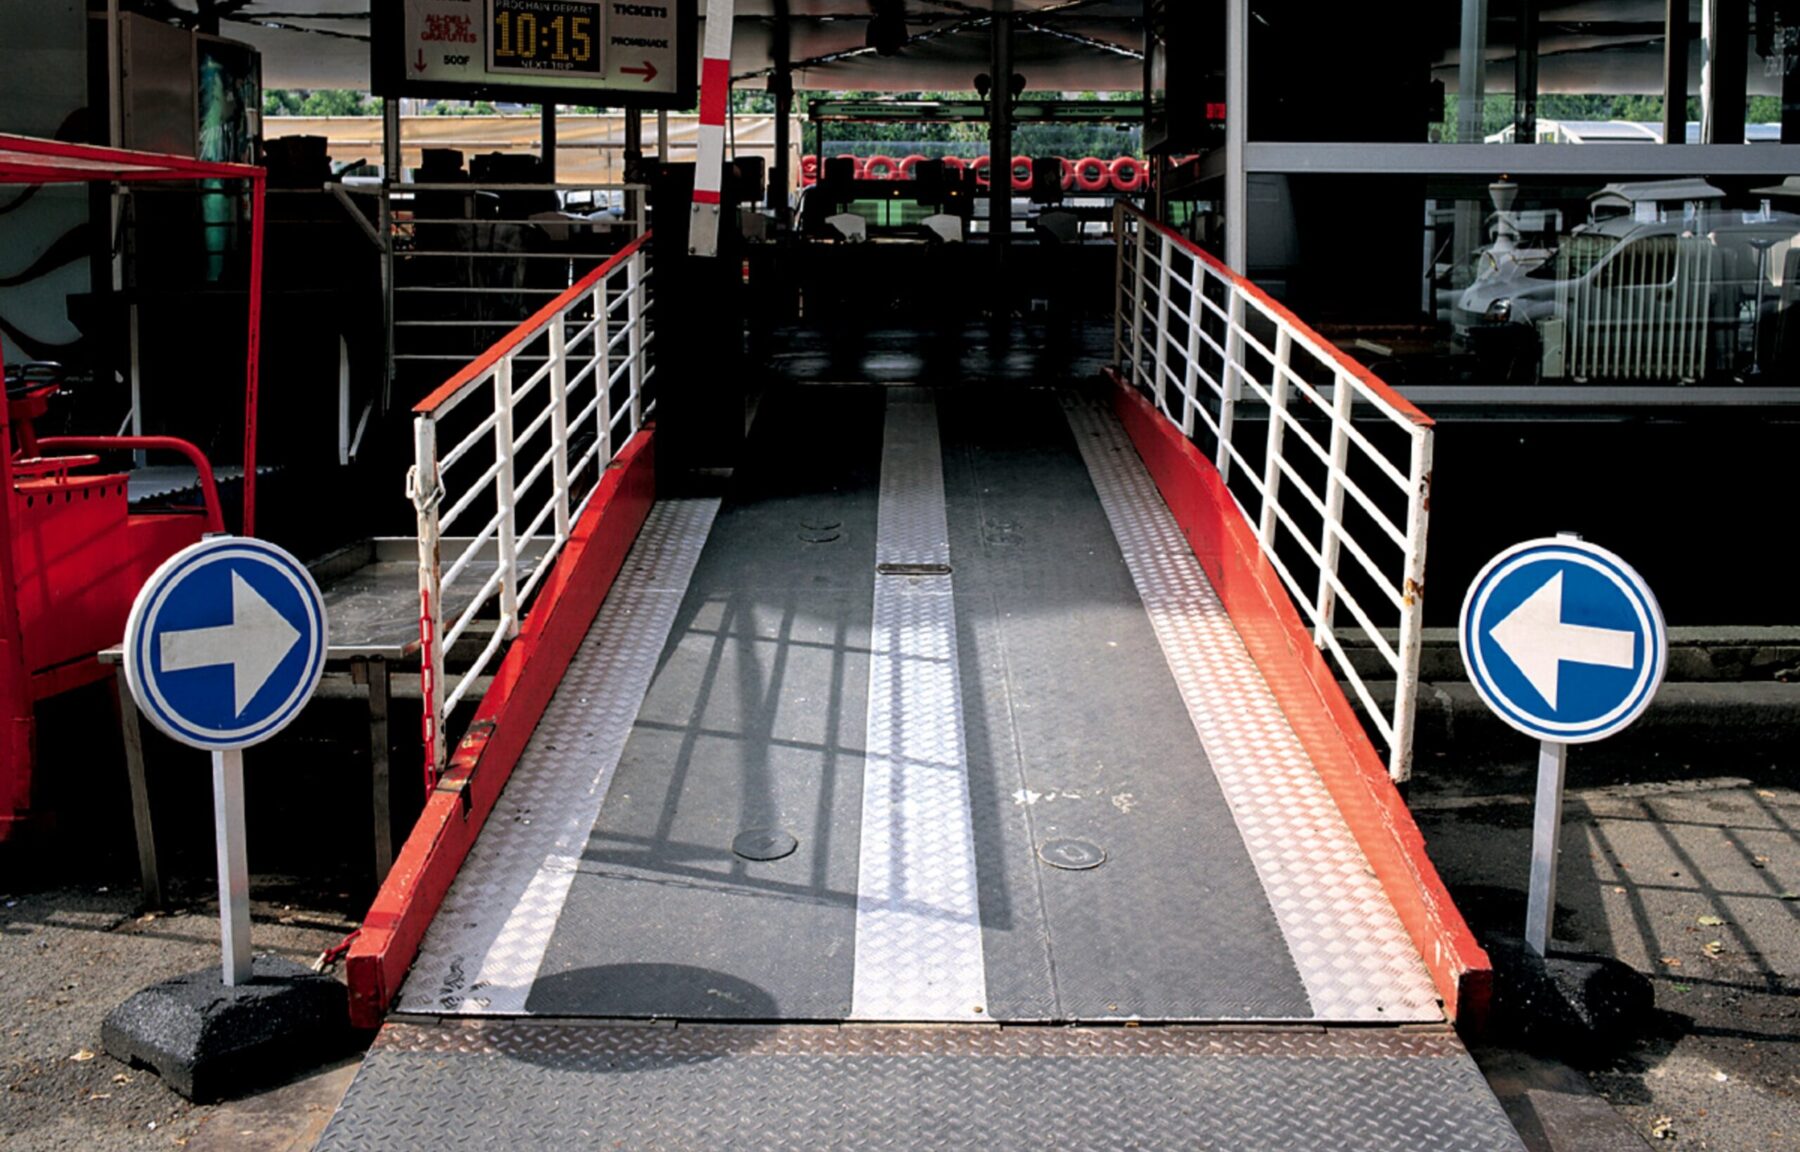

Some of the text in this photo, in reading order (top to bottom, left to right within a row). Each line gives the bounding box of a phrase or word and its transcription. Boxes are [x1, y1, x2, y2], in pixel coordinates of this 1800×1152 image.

[613, 4, 667, 18] TICKETS
[421, 31, 477, 43] GRATUITES
[496, 11, 590, 60] 10:15
[611, 36, 668, 48] PROMENADE
[444, 55, 470, 65] 500F
[521, 61, 548, 69] NEXT
